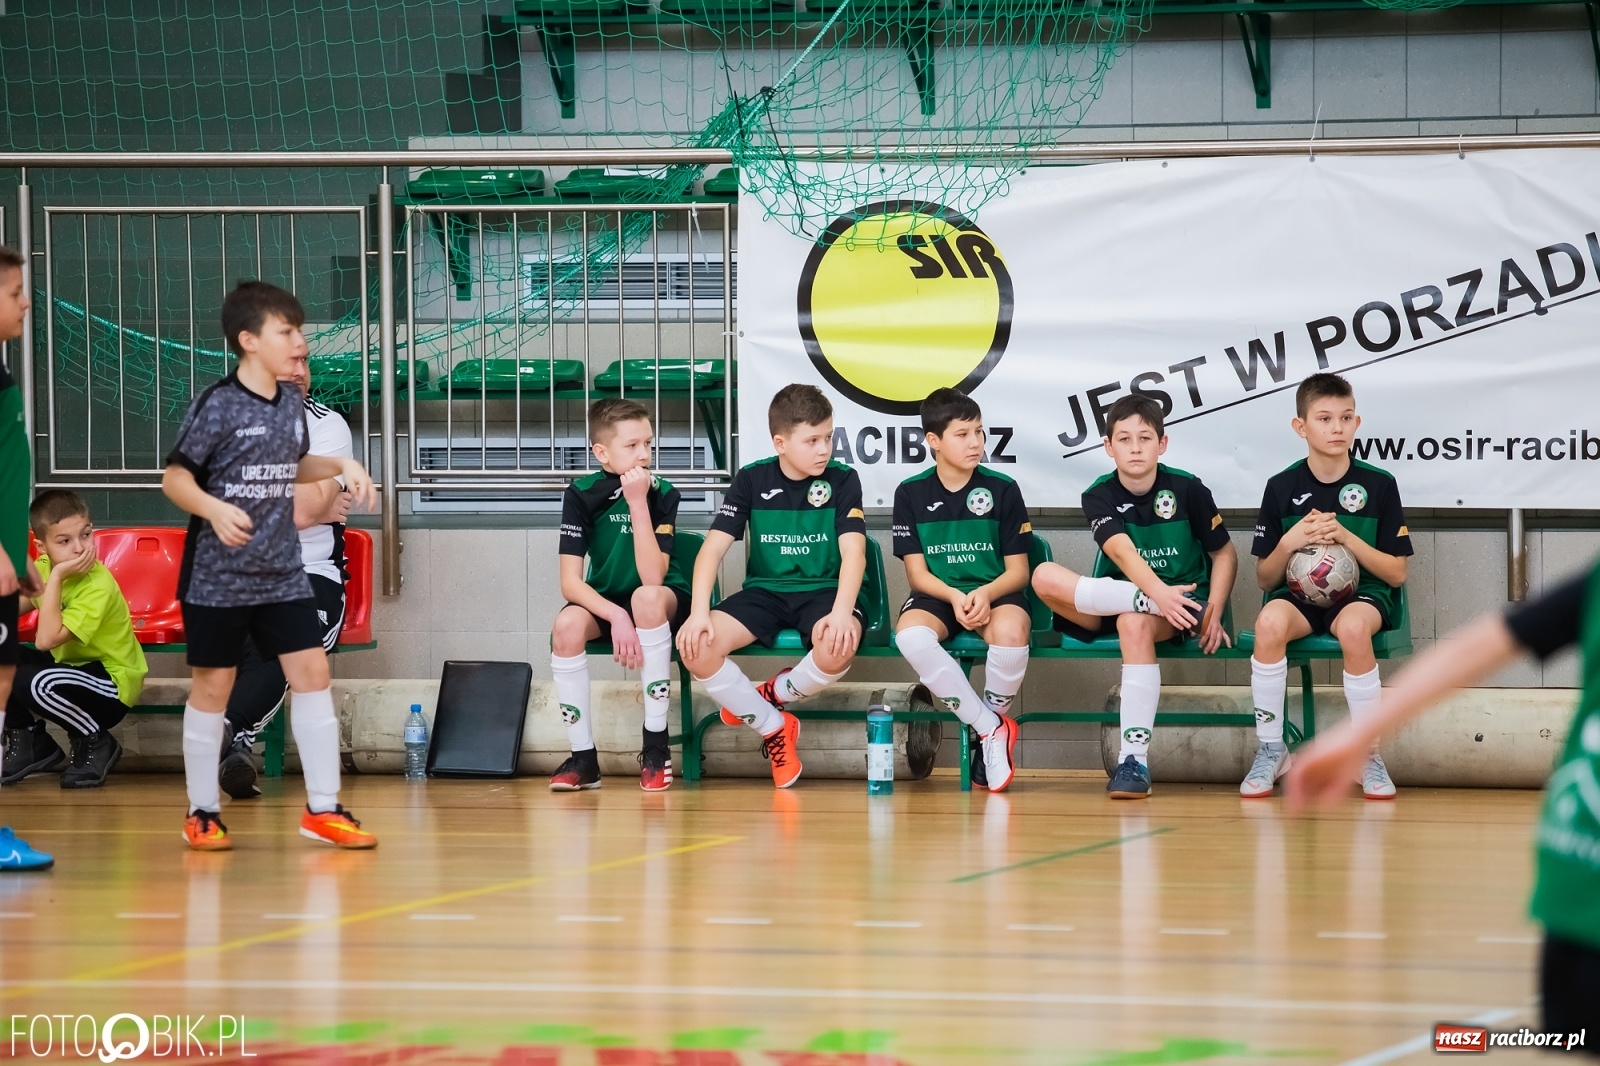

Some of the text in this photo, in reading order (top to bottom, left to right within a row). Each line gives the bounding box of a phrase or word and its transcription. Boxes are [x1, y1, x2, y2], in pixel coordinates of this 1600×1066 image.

[1223, 330, 1286, 392] W
[760, 533, 828, 544] RESTAURACJA
[780, 546, 810, 555] BRAVO
[927, 542, 994, 555] RESTAURACJA
[947, 554, 976, 564] BRAVO
